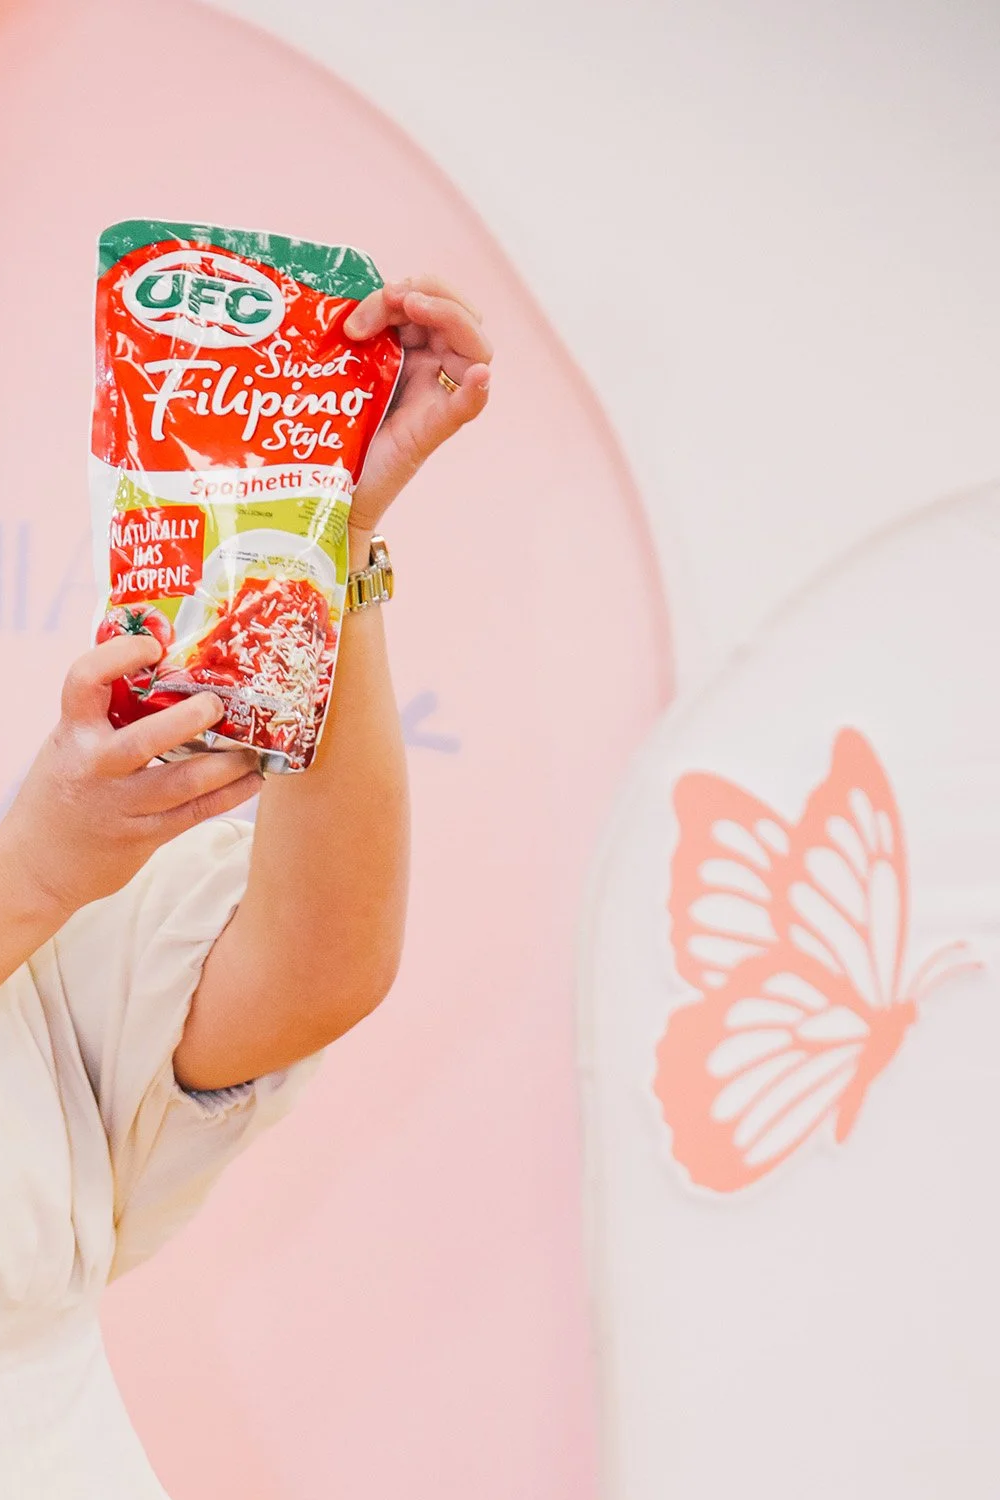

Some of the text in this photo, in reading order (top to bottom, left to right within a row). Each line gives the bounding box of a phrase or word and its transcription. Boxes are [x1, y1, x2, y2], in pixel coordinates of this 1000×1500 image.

[135, 274, 273, 325] UFC
[254, 339, 362, 379] Sweet
[143, 359, 373, 442] Filipino
[261, 418, 344, 460] Style
[190, 470, 302, 498] Spaghetti
[110, 518, 199, 549] NATURALLY
[133, 543, 163, 567] HAS
